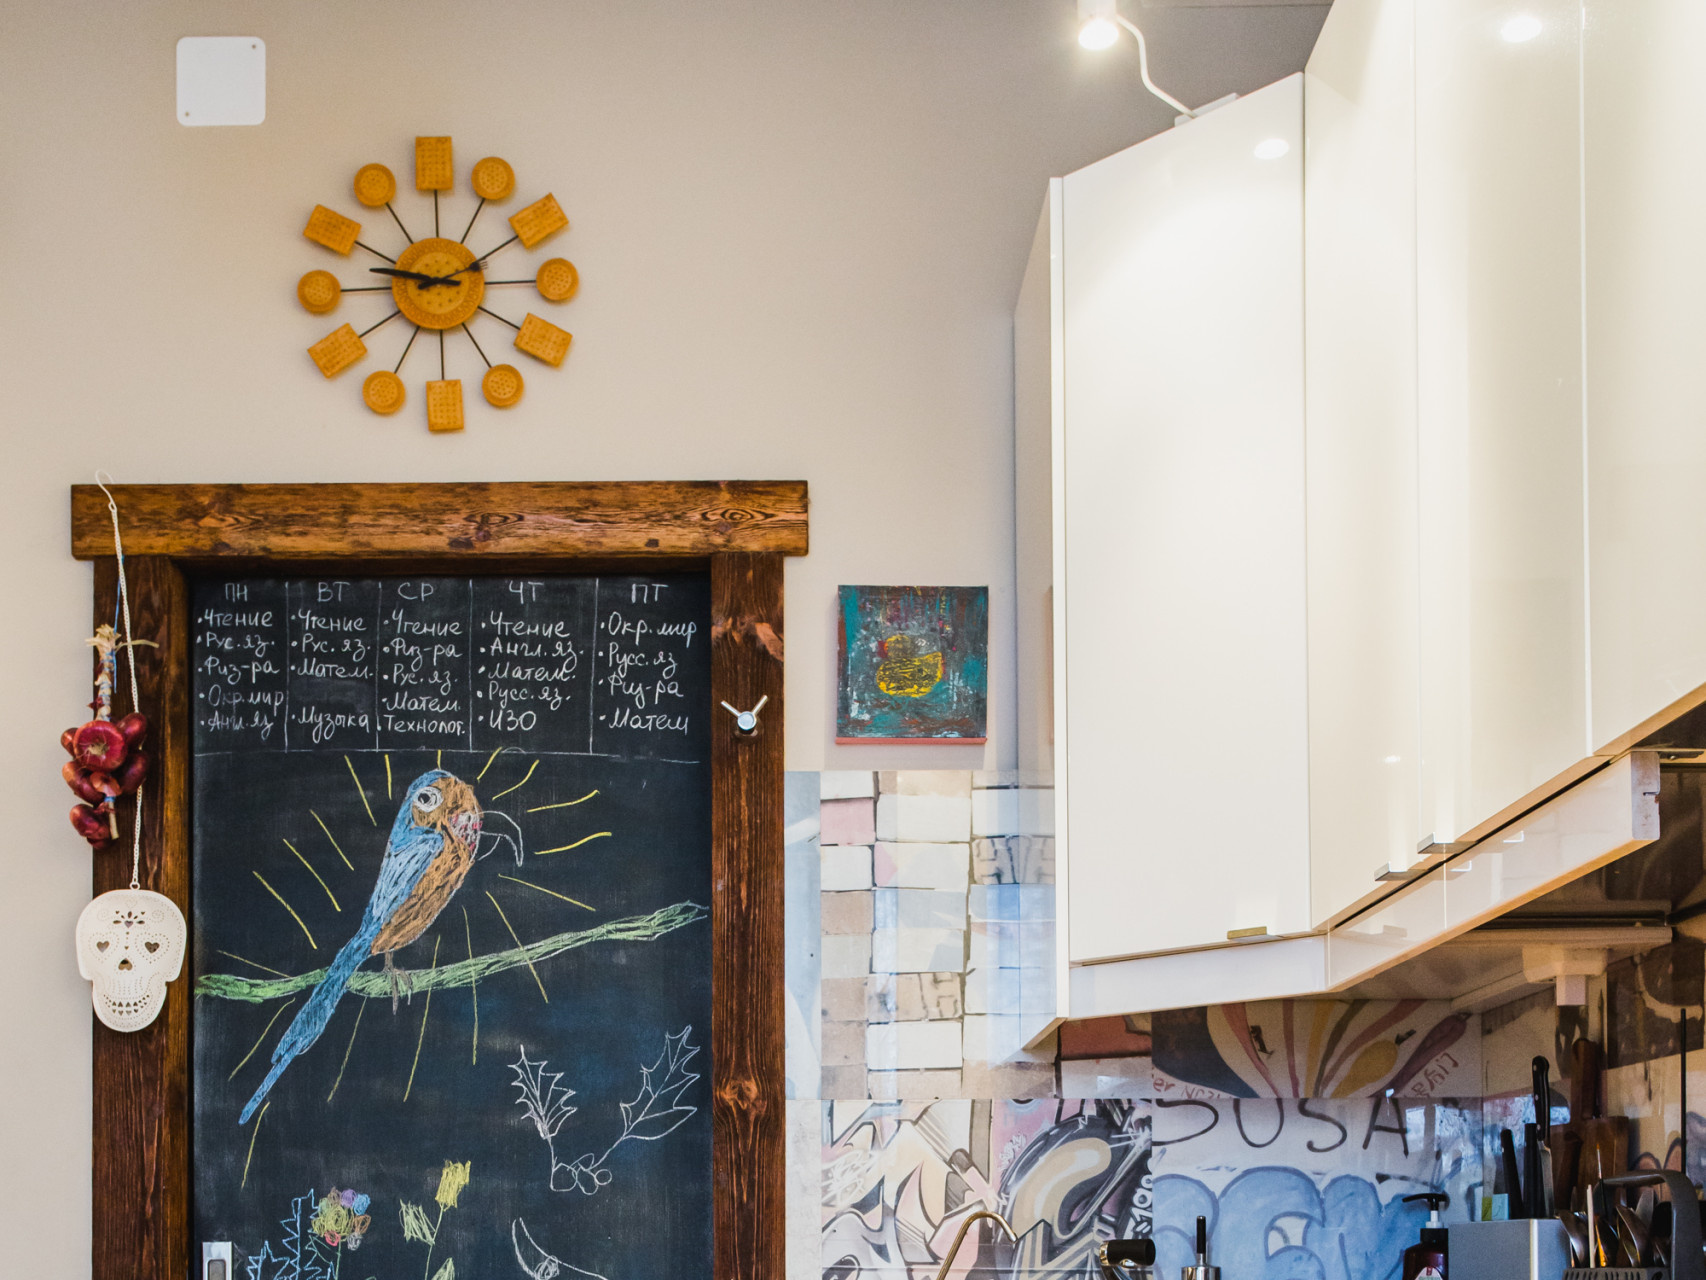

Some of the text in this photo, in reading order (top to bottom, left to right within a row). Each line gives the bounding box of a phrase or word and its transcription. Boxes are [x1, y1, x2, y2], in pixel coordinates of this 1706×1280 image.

[225, 582, 248, 602] ПН
[317, 581, 350, 602] ВТ
[398, 582, 434, 601] СР
[509, 580, 544, 604] ЧТ
[631, 583, 669, 604] ПТ
[204, 608, 273, 627] Чтение
[298, 608, 367, 632] Чтение
[392, 608, 463, 636] Чтение
[490, 610, 570, 638] Чтение
[390, 638, 463, 672] Физ-ра
[204, 655, 280, 685] Физ-ра
[297, 657, 373, 679] Матем.
[488, 662, 576, 682] Матем.
[490, 709, 537, 731] ИЗО
[609, 707, 689, 736] Матем
